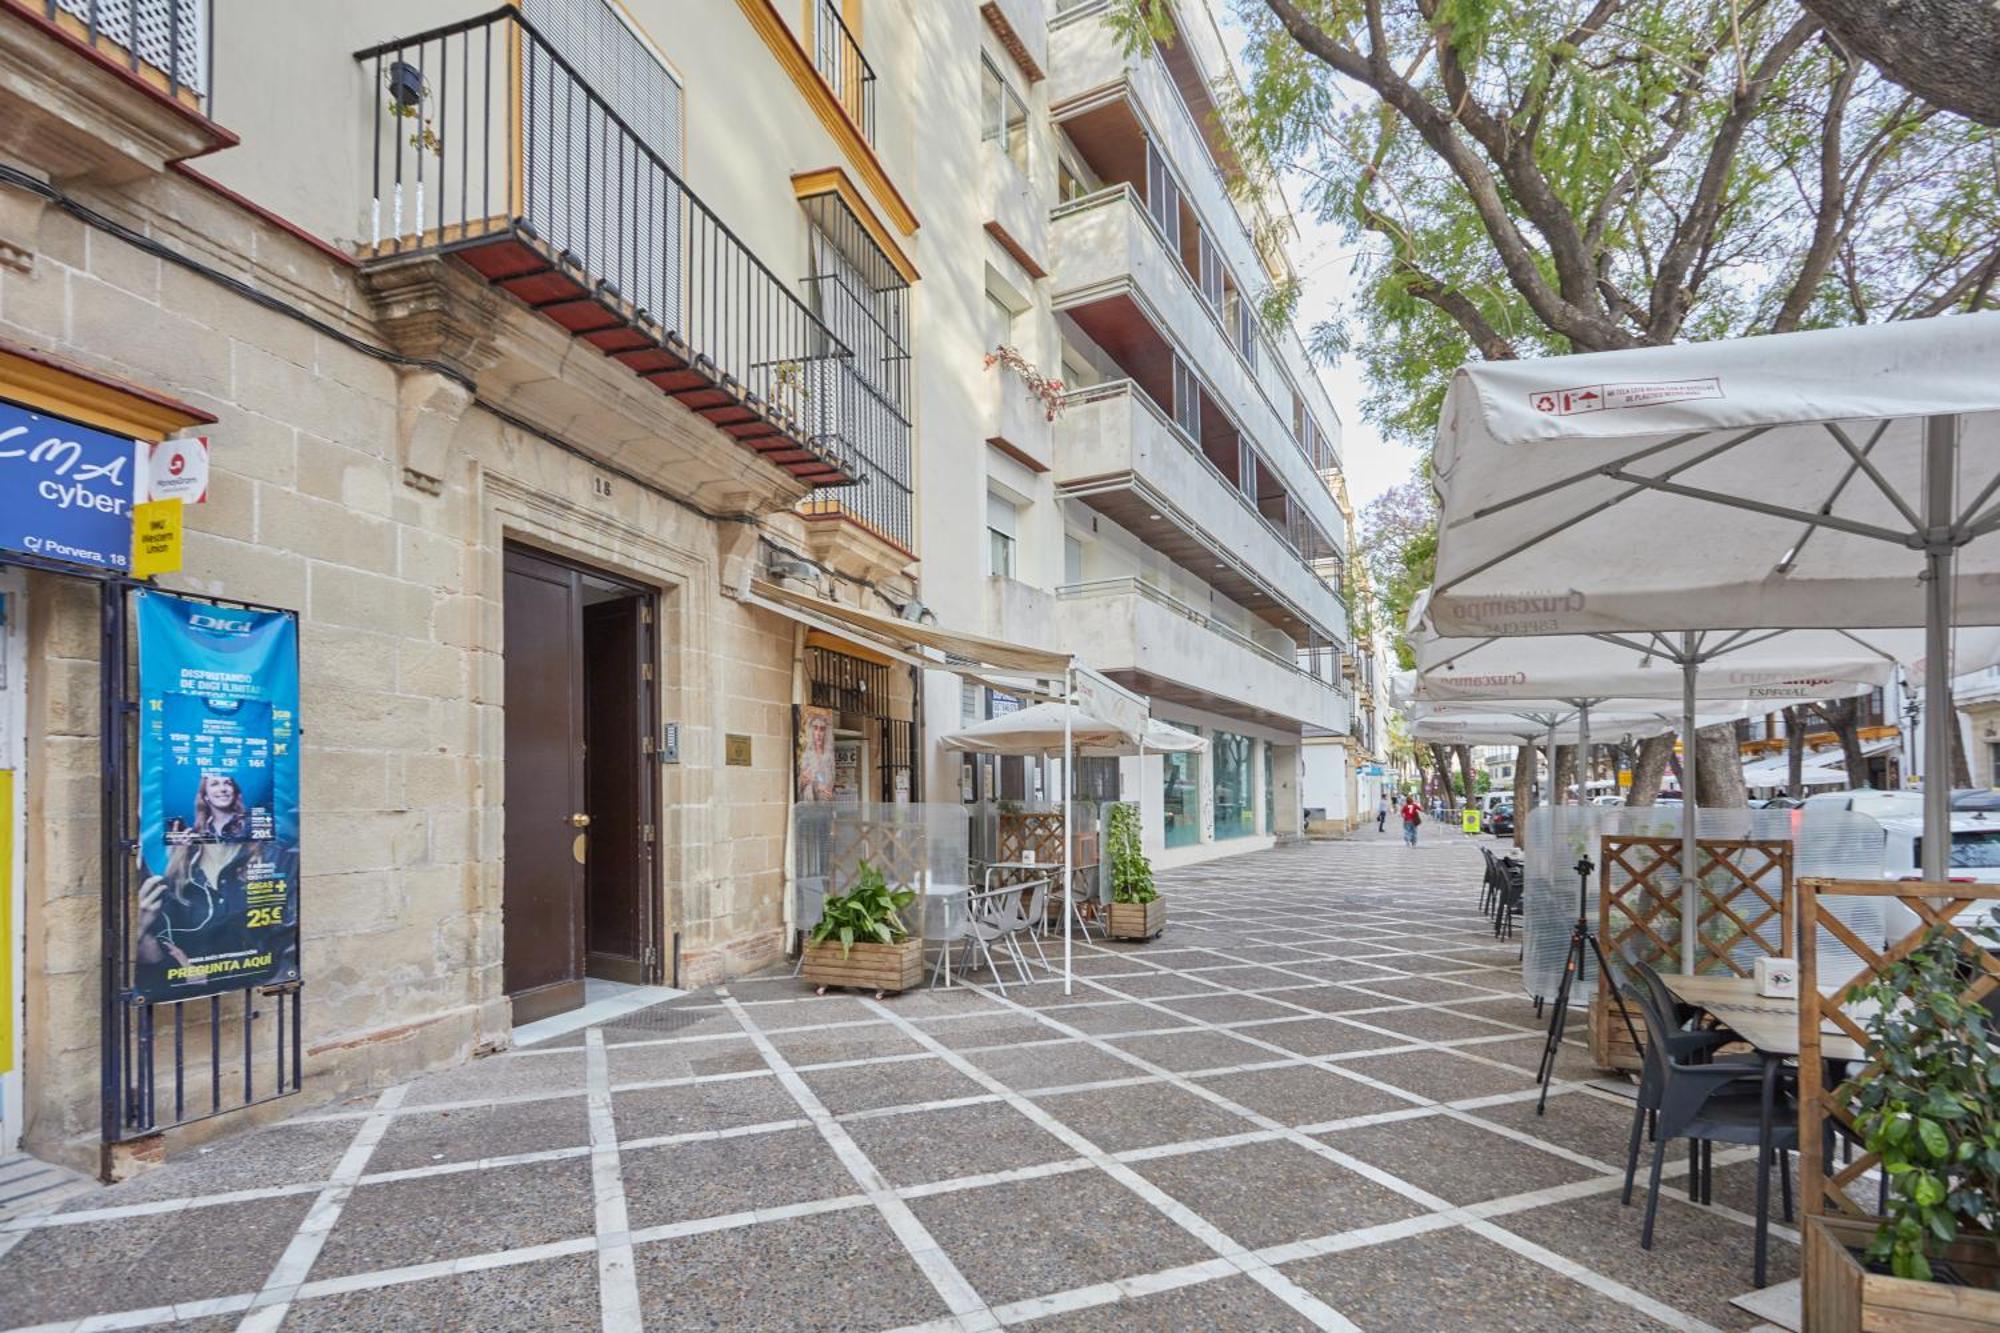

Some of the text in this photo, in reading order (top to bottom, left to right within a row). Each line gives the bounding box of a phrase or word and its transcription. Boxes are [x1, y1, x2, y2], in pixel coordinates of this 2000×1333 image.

[596, 477, 611, 497] 18
[110, 554, 127, 566] 18
[189, 614, 253, 633] DIGI
[246, 906, 283, 927] 25€
[167, 960, 240, 980] PREGUNTA
